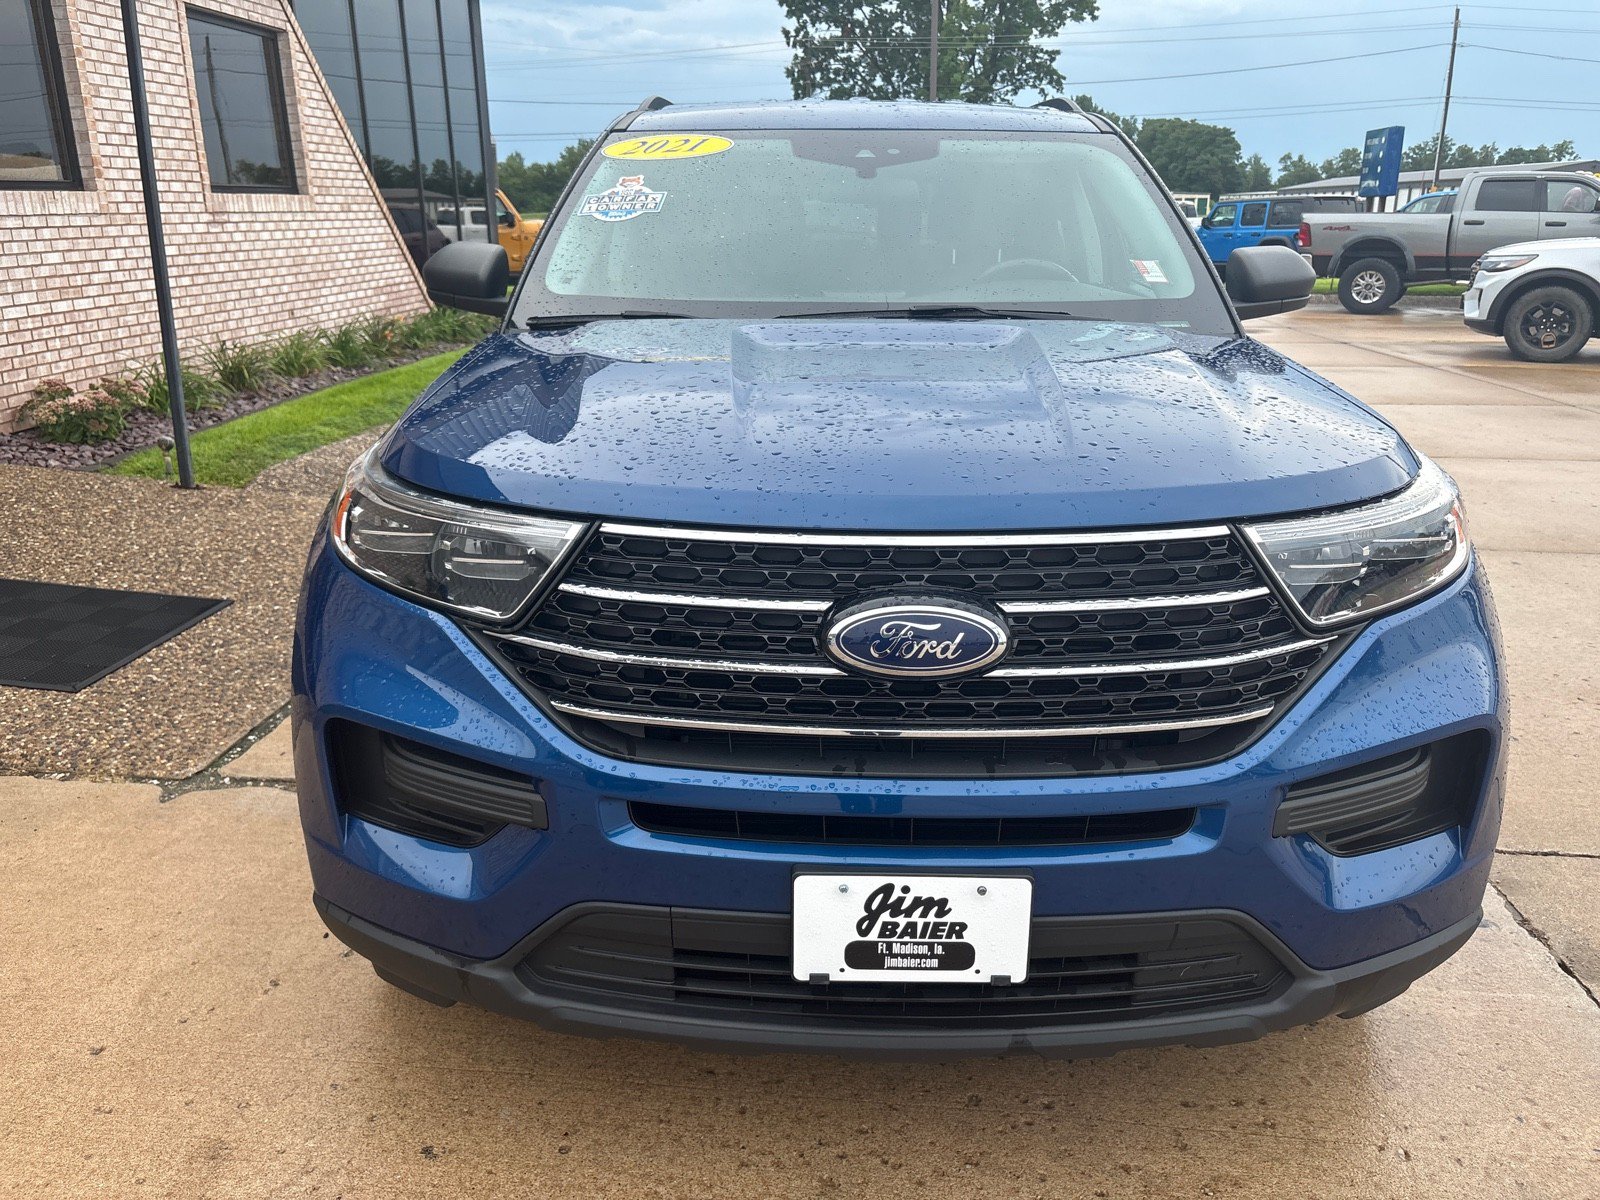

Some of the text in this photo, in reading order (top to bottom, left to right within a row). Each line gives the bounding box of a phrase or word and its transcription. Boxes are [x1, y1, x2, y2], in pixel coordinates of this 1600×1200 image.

[619, 138, 710, 156] 2021
[588, 194, 659, 205] CARFAX
[870, 621, 965, 660] Ford
[856, 882, 953, 938] Jim
[877, 920, 969, 940] BAIER
[877, 942, 890, 954] Ft.
[892, 942, 932, 956] Madison,
[883, 956, 940, 969] jimbaier.com
